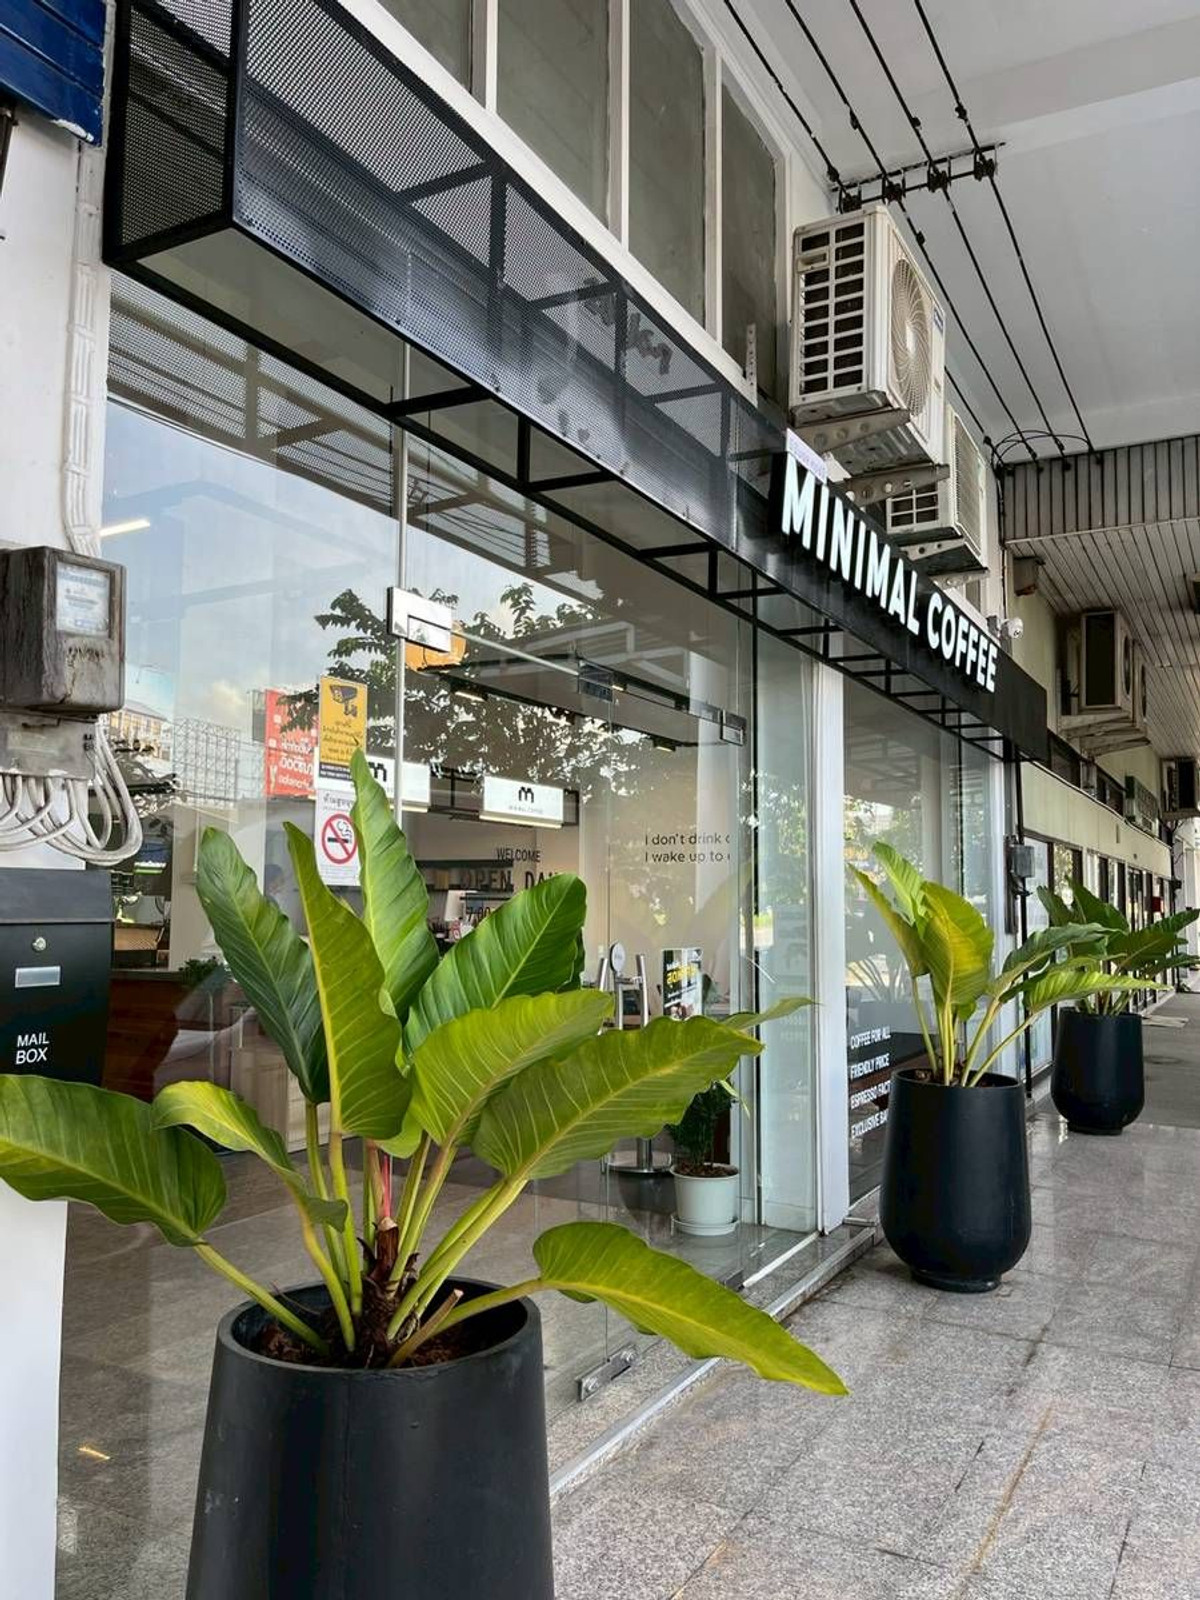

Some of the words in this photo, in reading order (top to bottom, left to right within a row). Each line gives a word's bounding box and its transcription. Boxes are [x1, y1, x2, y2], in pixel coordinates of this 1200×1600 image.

[782, 453, 919, 636] MINIMAL
[927, 592, 998, 693] COFFEE
[652, 833, 685, 845] don't
[689, 832, 721, 844] drink
[496, 847, 541, 863] WELCOME
[652, 851, 685, 862] wake
[689, 854, 706, 864] up
[710, 851, 723, 861] to
[460, 869, 513, 892] OPEN
[17, 1032, 49, 1047] MAIL
[850, 1030, 871, 1050] COFFEE
[871, 1028, 881, 1043] FOR
[15, 1047, 47, 1064] BOX
[875, 1053, 889, 1070] PRICE
